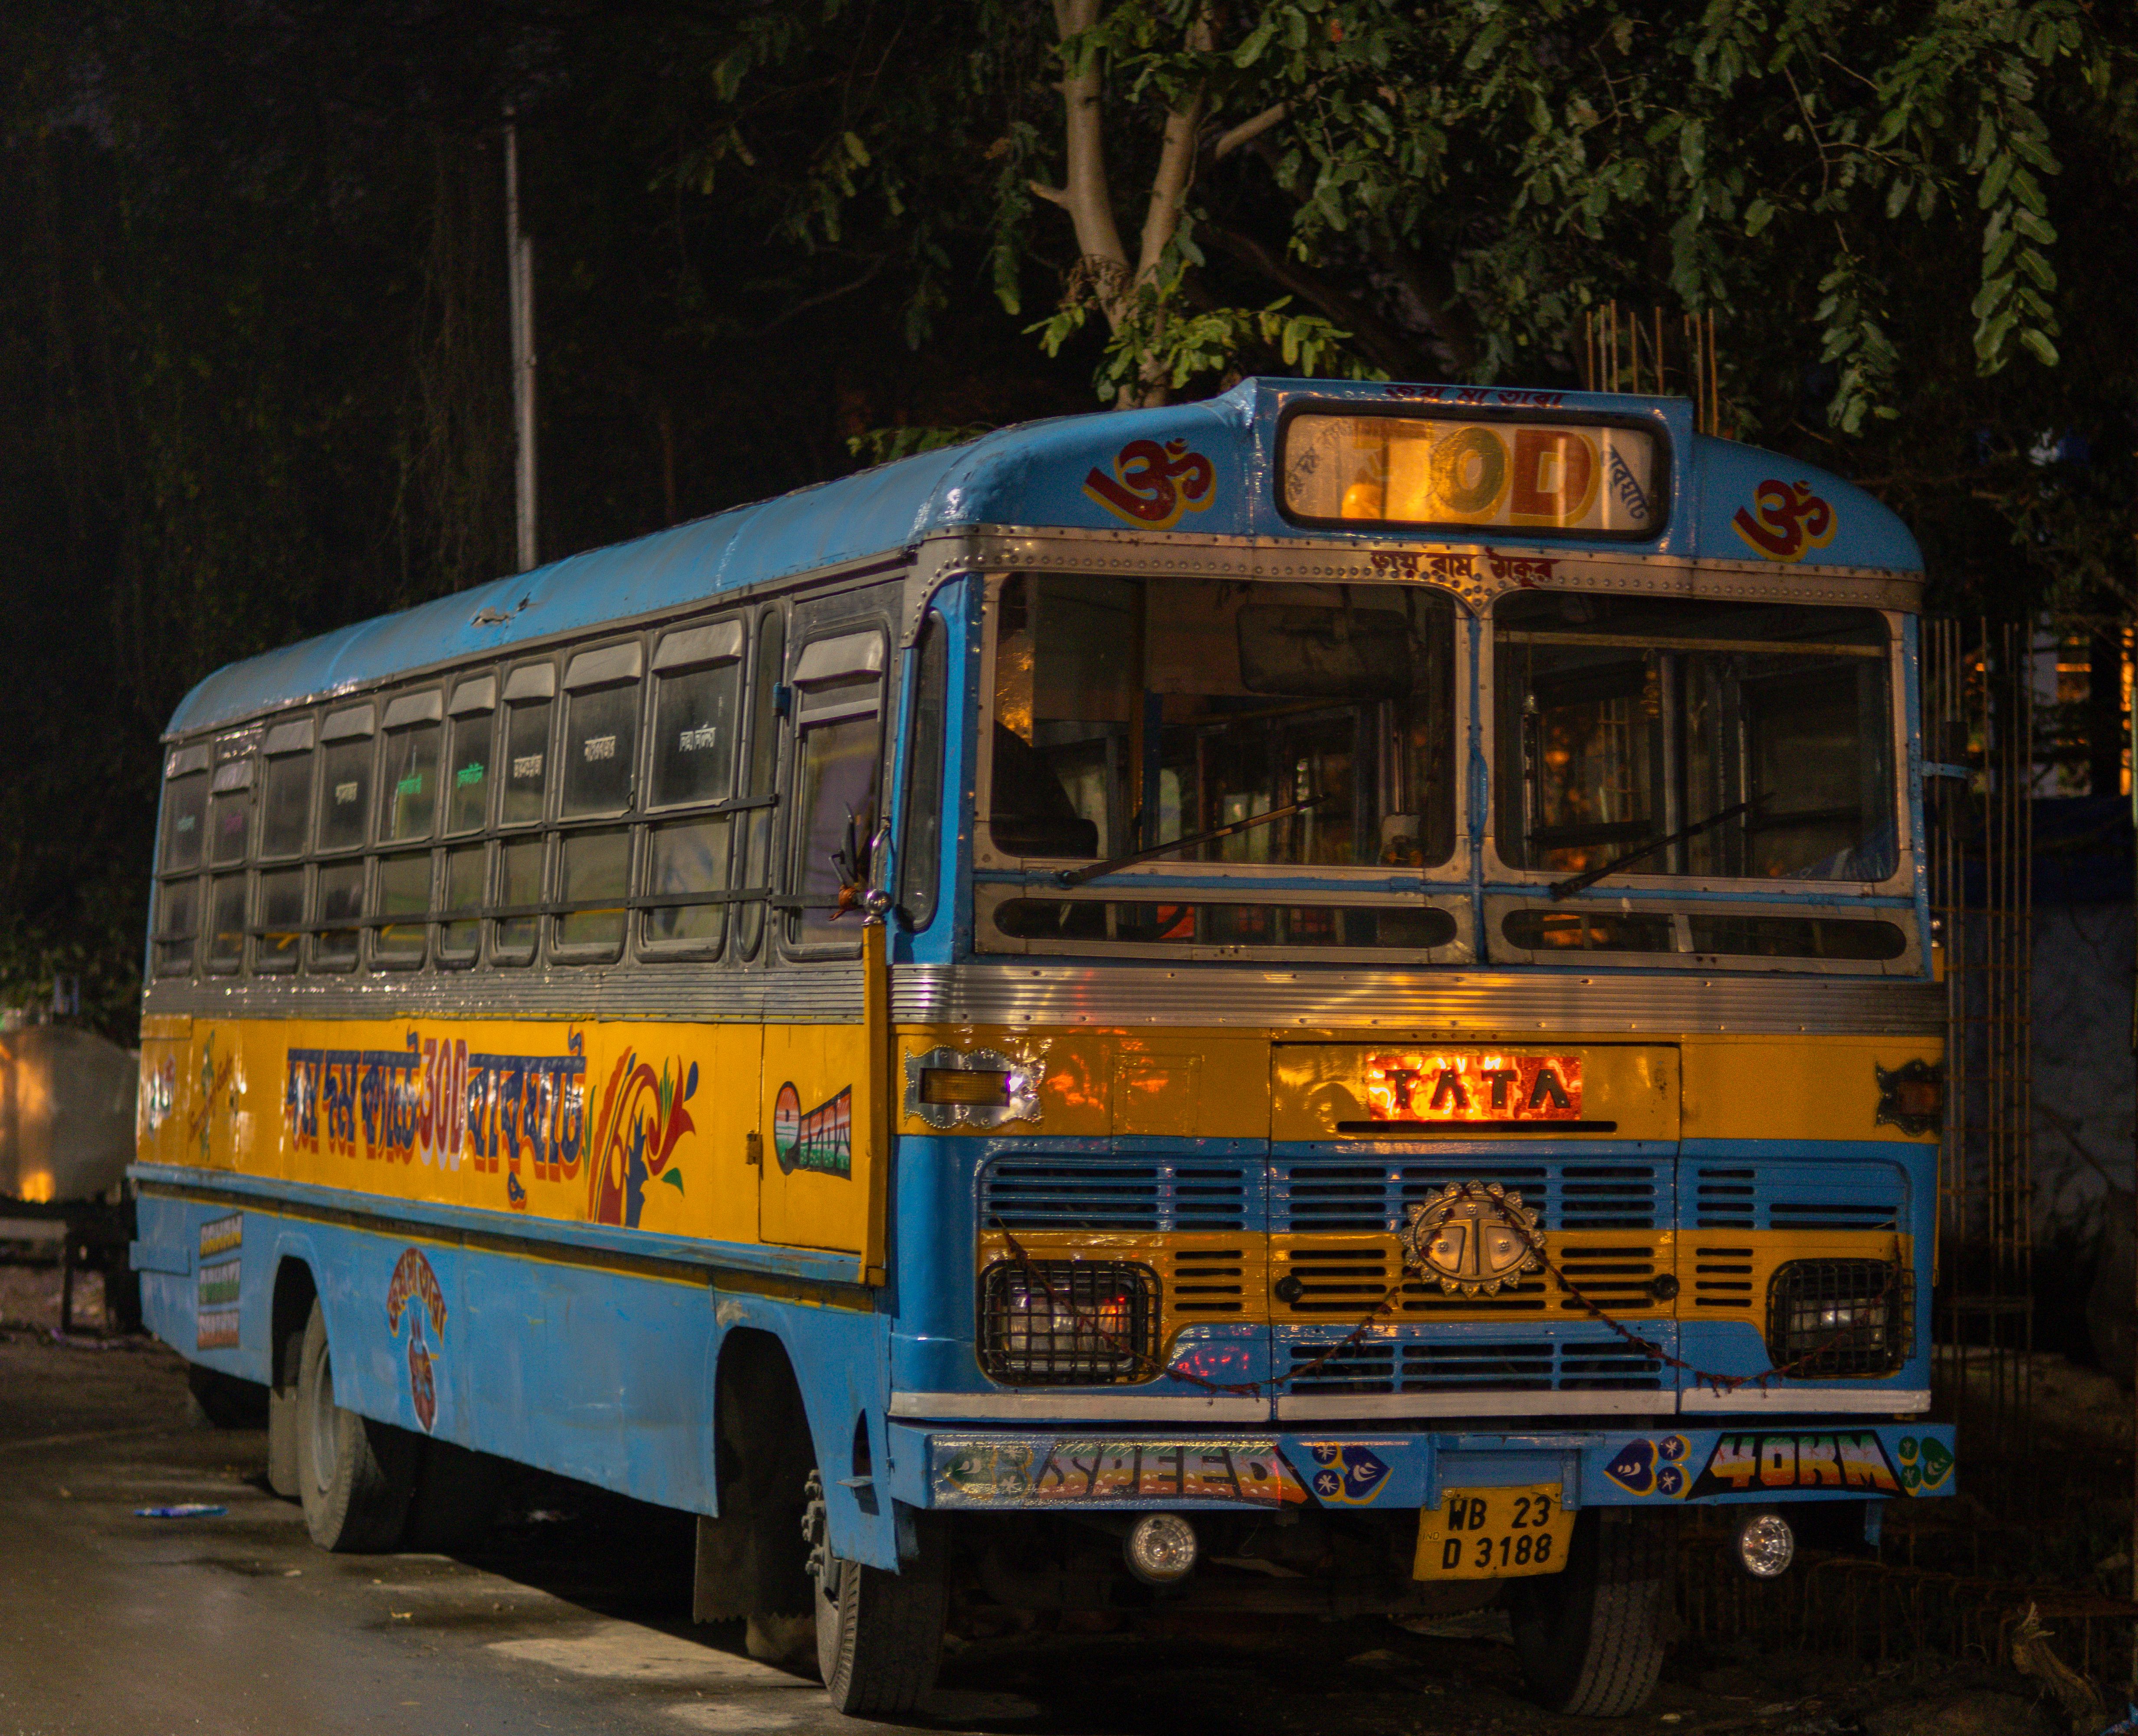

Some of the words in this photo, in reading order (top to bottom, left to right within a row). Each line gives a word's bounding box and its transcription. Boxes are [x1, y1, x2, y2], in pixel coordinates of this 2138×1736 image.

[323, 1049, 361, 1158] দম
[467, 1023, 588, 1210] বাবুঘাট
[1384, 1068, 1571, 1110] TATA
[1031, 1439, 1317, 1508] SPEED
[1699, 1431, 1906, 1493] 40KM
[1448, 1498, 1487, 1531] WB
[1512, 1495, 1551, 1529] 23
[1442, 1538, 1462, 1569] D
[1475, 1533, 1553, 1568] 3188
